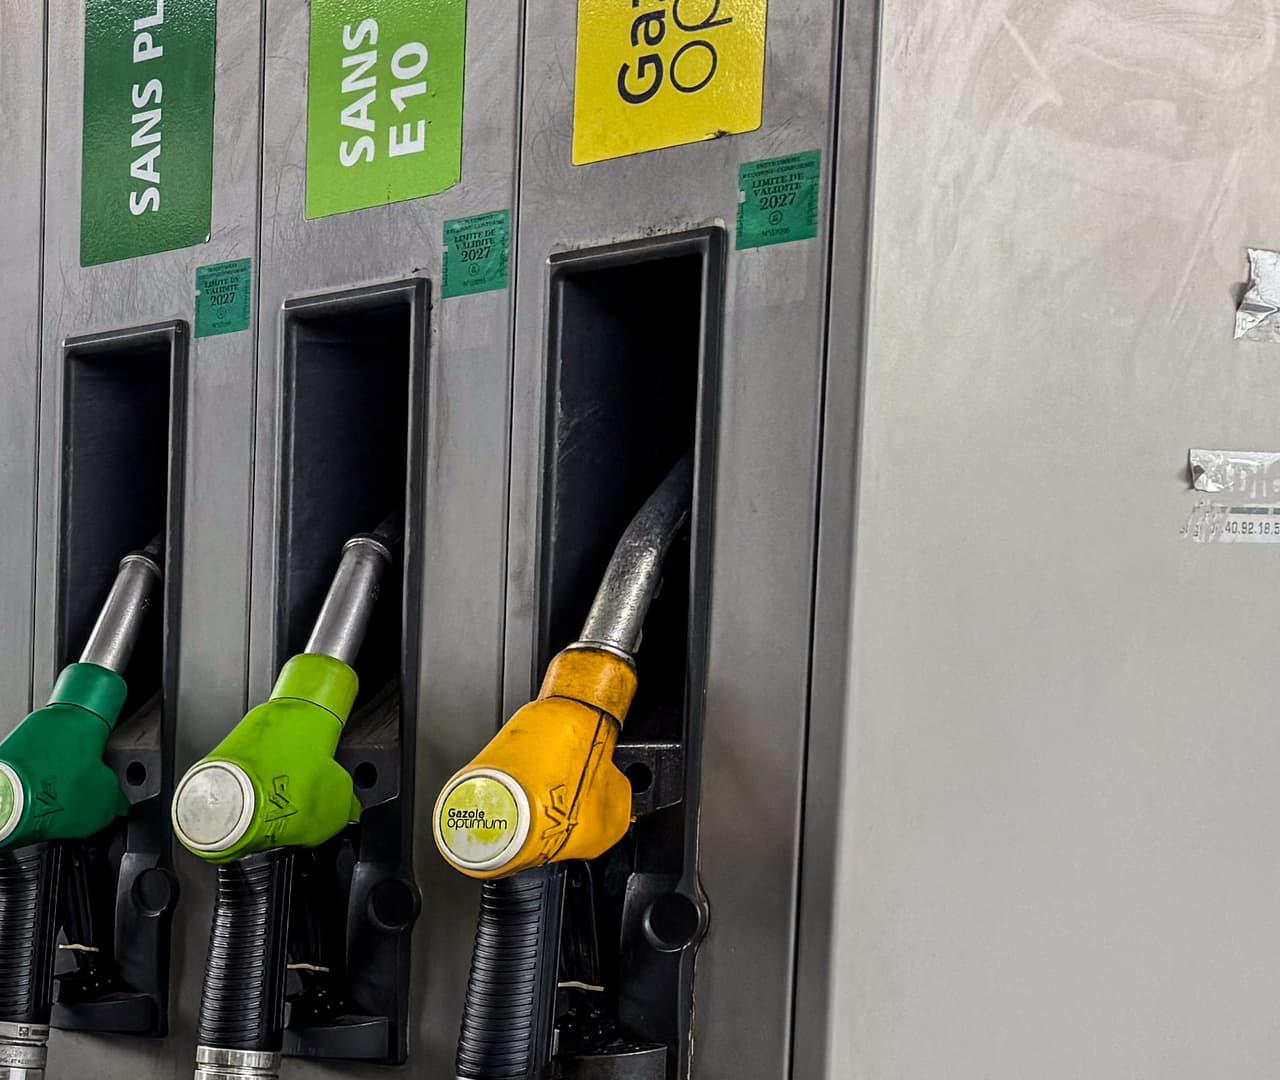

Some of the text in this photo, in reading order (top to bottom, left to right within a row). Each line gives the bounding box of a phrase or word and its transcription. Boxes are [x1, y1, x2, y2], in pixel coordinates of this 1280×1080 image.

[617, 0, 666, 105] Ga
[340, 18, 379, 167] SANS
[130, 0, 164, 216] SANS PL
[752, 172, 804, 189] LIMITE DE
[759, 192, 797, 211] 2027
[460, 246, 491, 262] 2027
[209, 292, 236, 306] 2027
[447, 808, 485, 819] Gazole
[447, 818, 508, 830] optimum
